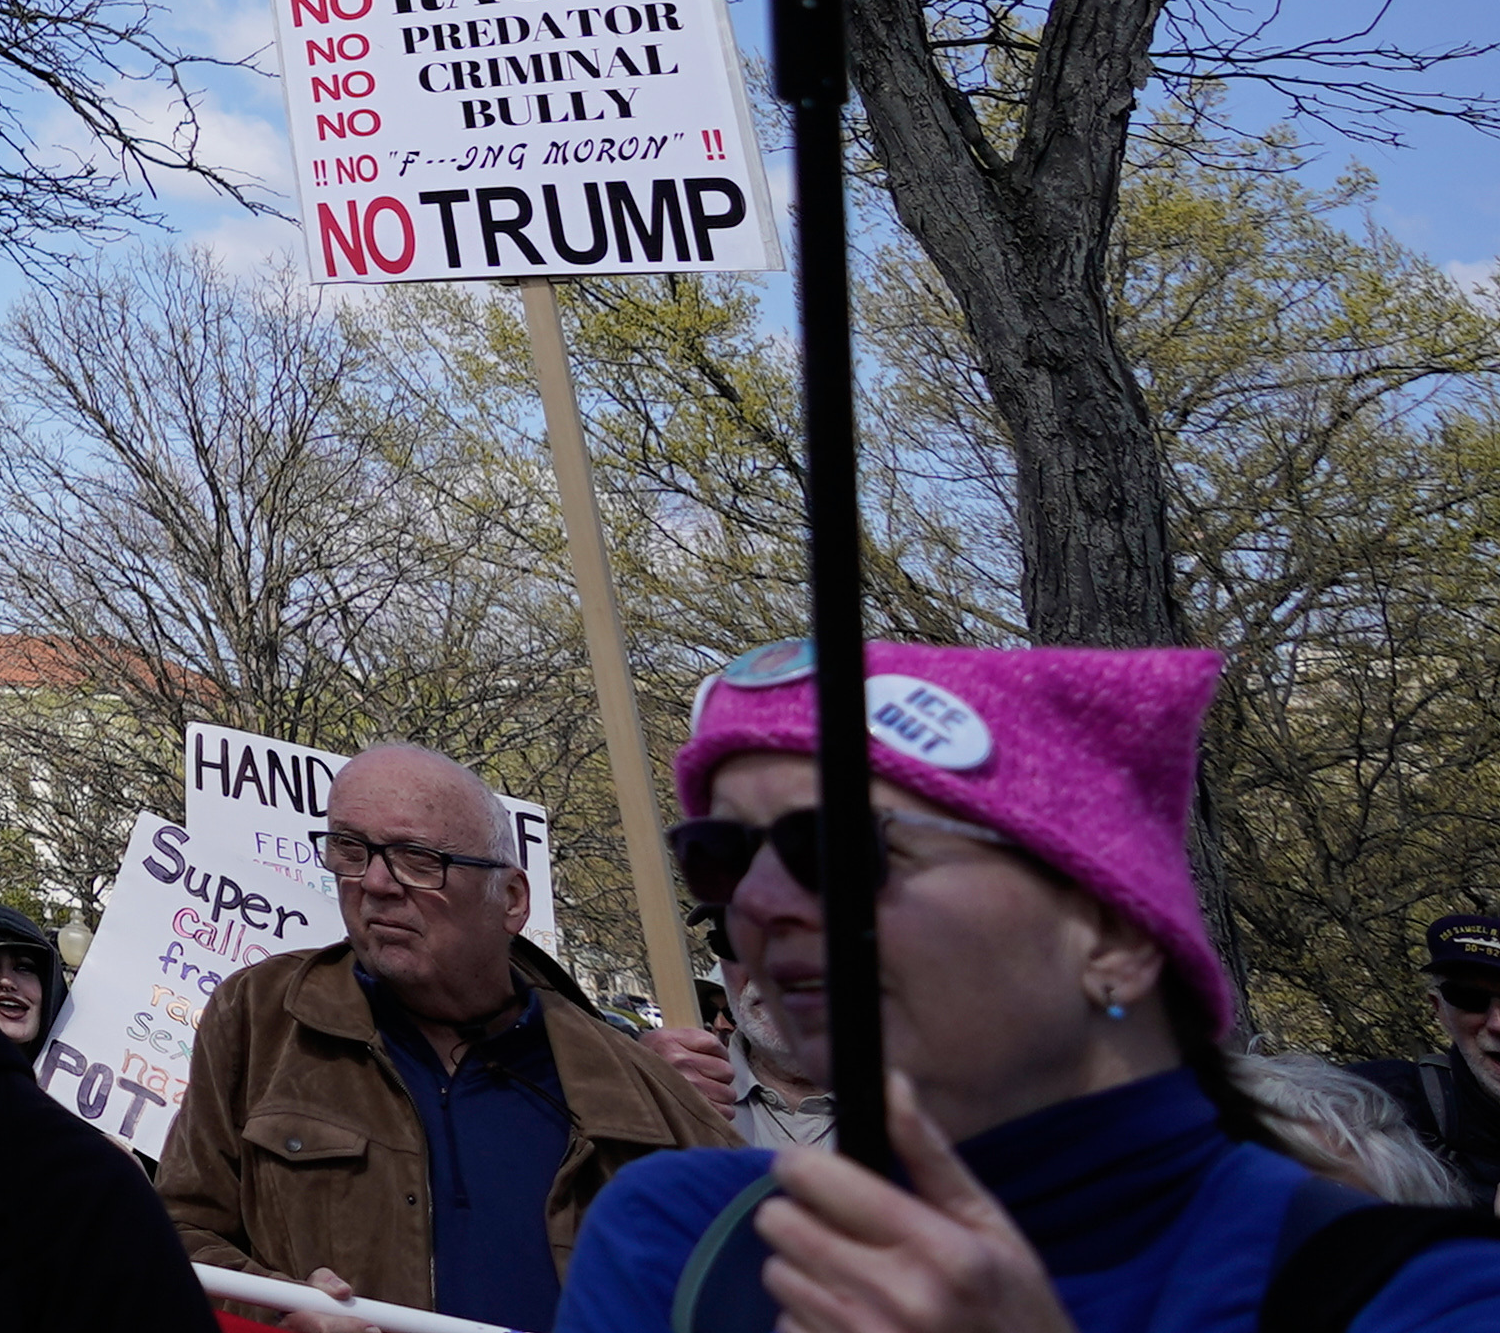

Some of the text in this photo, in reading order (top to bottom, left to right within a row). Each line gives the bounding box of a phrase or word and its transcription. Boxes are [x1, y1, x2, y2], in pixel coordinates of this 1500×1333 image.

[306, 1, 685, 67] NO PREDATOR
[311, 43, 680, 103] NO CRIMINAL
[316, 87, 641, 142] NO BULLY
[335, 153, 380, 185] NO
[317, 176, 748, 278] NO TRUMP
[872, 701, 951, 754] OUT
[903, 687, 969, 732] ICE
[142, 825, 308, 939] Super
[37, 1039, 170, 1140] POT
